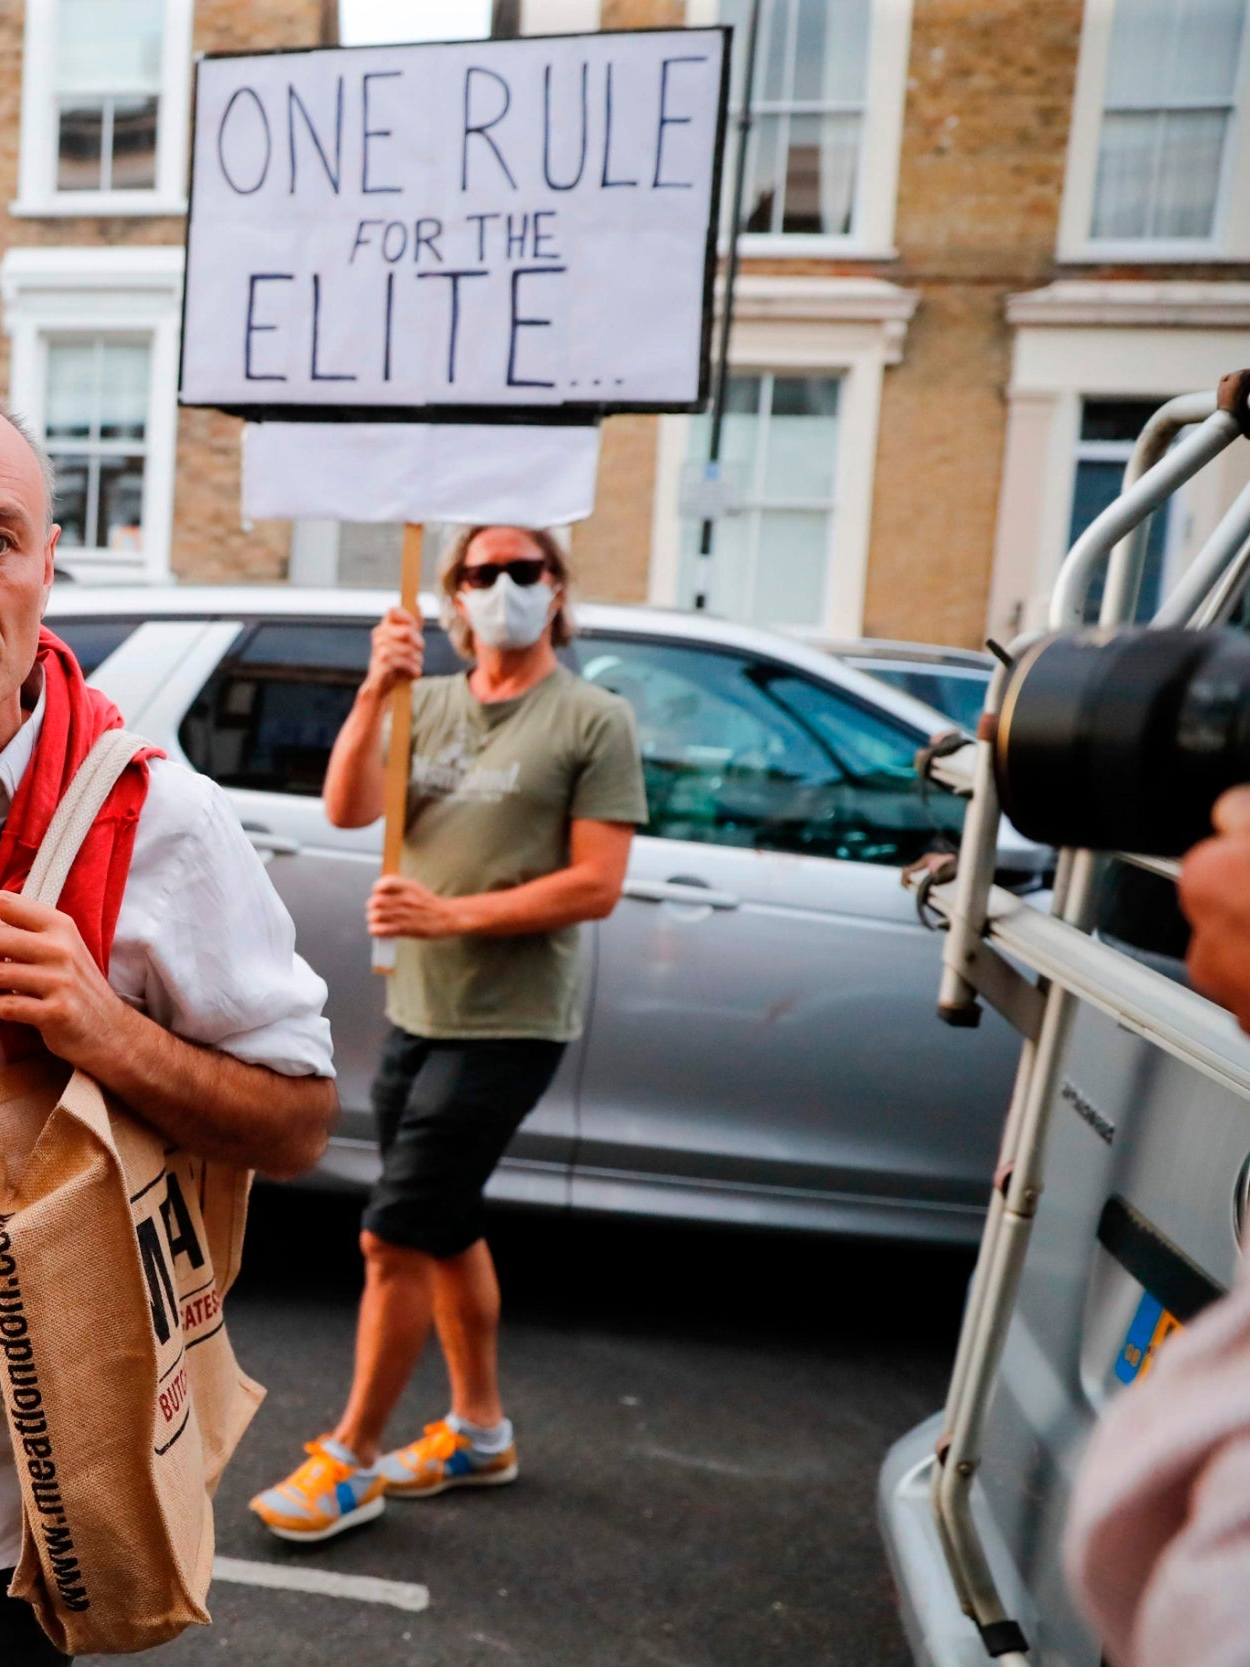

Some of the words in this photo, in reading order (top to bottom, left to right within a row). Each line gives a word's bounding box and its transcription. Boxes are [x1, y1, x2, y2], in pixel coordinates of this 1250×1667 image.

[218, 72, 403, 194] ONE
[461, 57, 708, 192] RULE
[349, 217, 444, 264] FOR
[465, 211, 562, 262] THE
